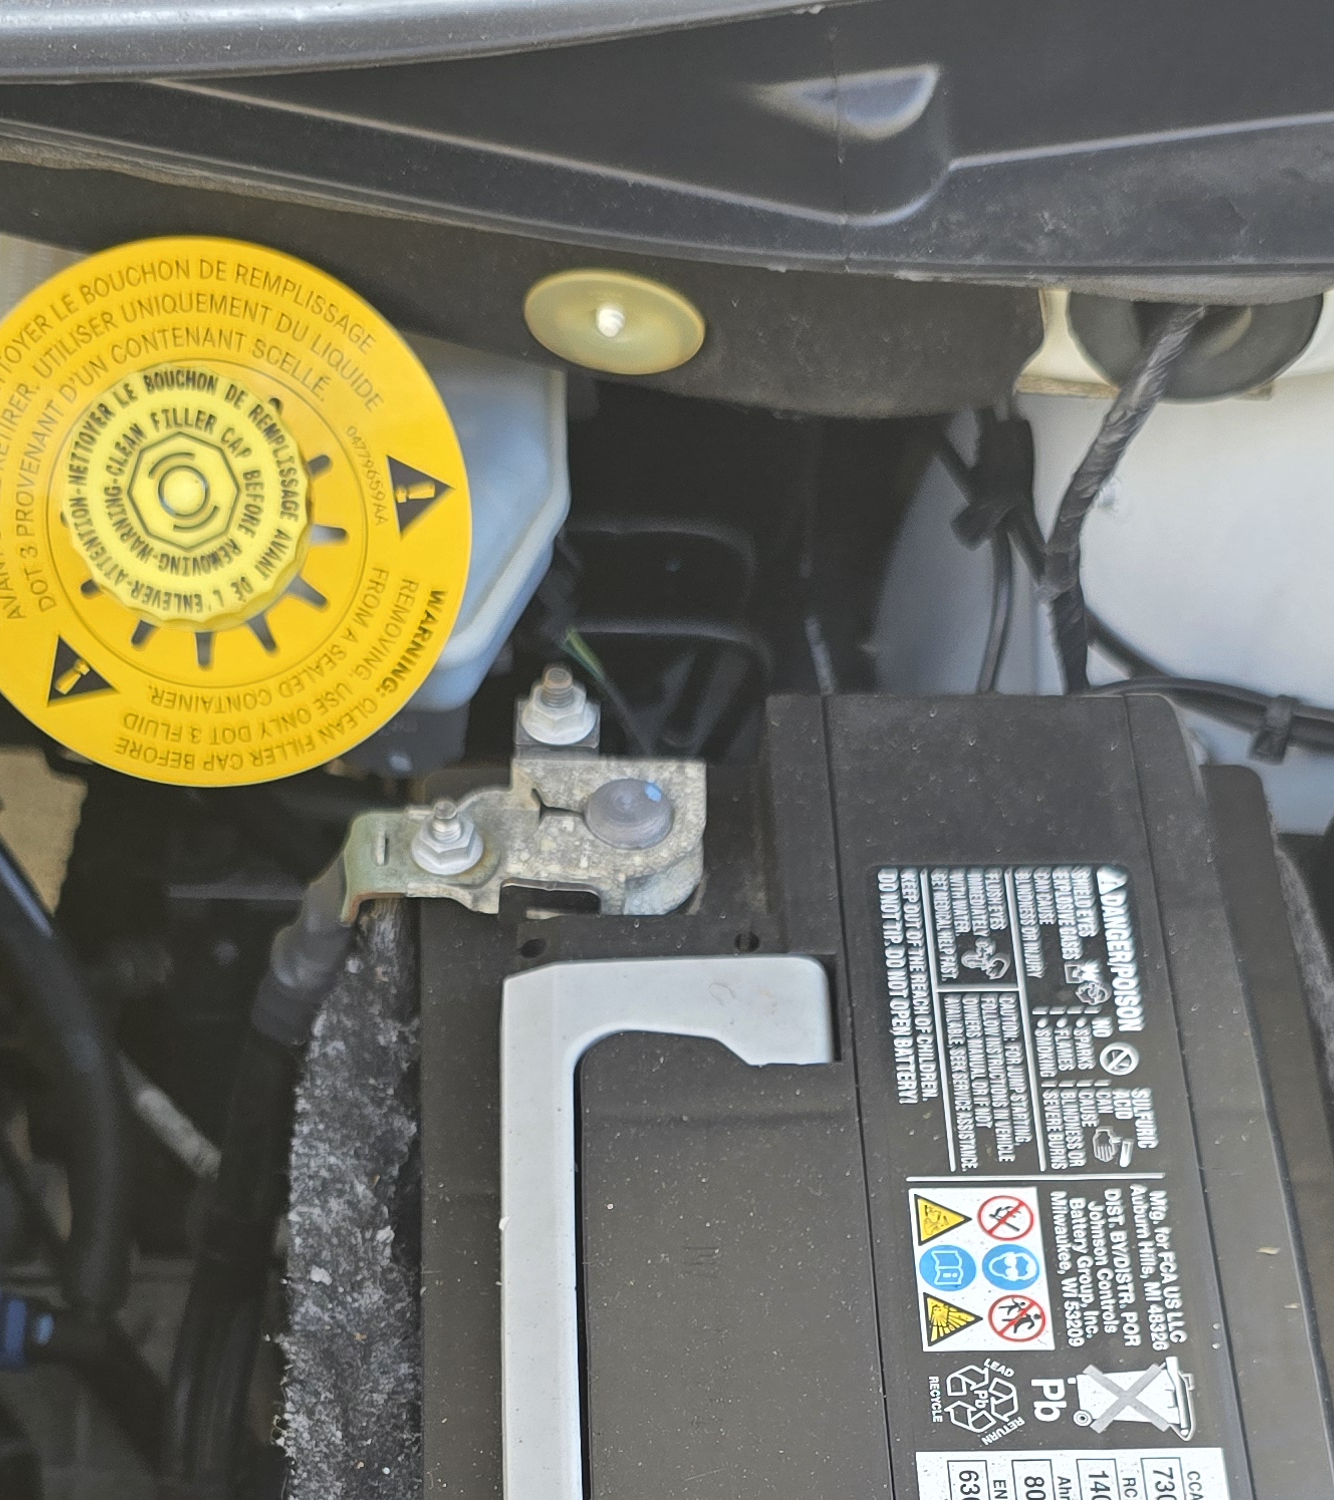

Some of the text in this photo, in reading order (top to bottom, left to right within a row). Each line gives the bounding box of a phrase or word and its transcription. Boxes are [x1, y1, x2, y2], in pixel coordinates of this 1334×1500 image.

[49, 293, 79, 322] LE
[78, 258, 190, 306] BOUCHON
[199, 258, 227, 281] DE
[234, 262, 376, 353] REMPLISSAGE
[31, 310, 119, 379] UTILISER
[129, 291, 272, 325] UNIQUEMENT
[275, 312, 309, 342] DU
[309, 333, 384, 413] LIQUIDE
[14, 325, 332, 613] DOT 3 PROVENANT D'UN CONTENANT SCELLÉ.
[112, 382, 139, 408] LE
[143, 369, 219, 395] BOUCHON
[224, 383, 249, 410] DE
[247, 403, 299, 523] REMPLISSAGE
[150, 407, 265, 539] FILLER CAP BEFORE
[122, 578, 419, 746] REMOVING. USE ONLY DOT 3 FLUID
[147, 567, 390, 714] FROM A SEALED CONTAINER.
[114, 590, 445, 771] WARNING: CLEAN FILLER CAP BEFORE
[1098, 893, 1145, 1031] DANGER/POISON
[1034, 1028, 1057, 1077] SMOKING
[1052, 1027, 1075, 1071] FLAMES
[1072, 1028, 1096, 1070] SPARKS
[1090, 1016, 1112, 1037] NO
[1041, 1089, 1068, 1169] SEVERE BURNS
[1059, 1089, 1087, 1167] BLINDNESS OR
[1077, 1089, 1098, 1127] CAUSE
[1094, 1089, 1114, 1113] CAN
[1111, 1089, 1133, 1119] ACID
[1129, 1087, 1159, 1148] SULFURIC
[1047, 1191, 1085, 1347] Milwaukee, WI 53209
[1064, 1197, 1103, 1338] Battery Group, Inc.
[1086, 1200, 1121, 1333] Johnson Controls
[1103, 1188, 1141, 1346] DIST. BY/DISTR. POR
[1128, 1184, 1168, 1351] Auburn Hills, MI 48326
[1145, 1190, 1187, 1343] Mfg. for FCA US LLC
[927, 1375, 944, 1422] RECYCLE
[972, 1389, 989, 1408] Pb
[983, 1358, 1015, 1378] LEAD
[1029, 1378, 1069, 1422] Pb
[981, 1416, 1025, 1446] RETURN
[991, 1479, 1008, 1499] EN
[1056, 1475, 1073, 1500] Ahr
[1121, 1477, 1138, 1498] RC
